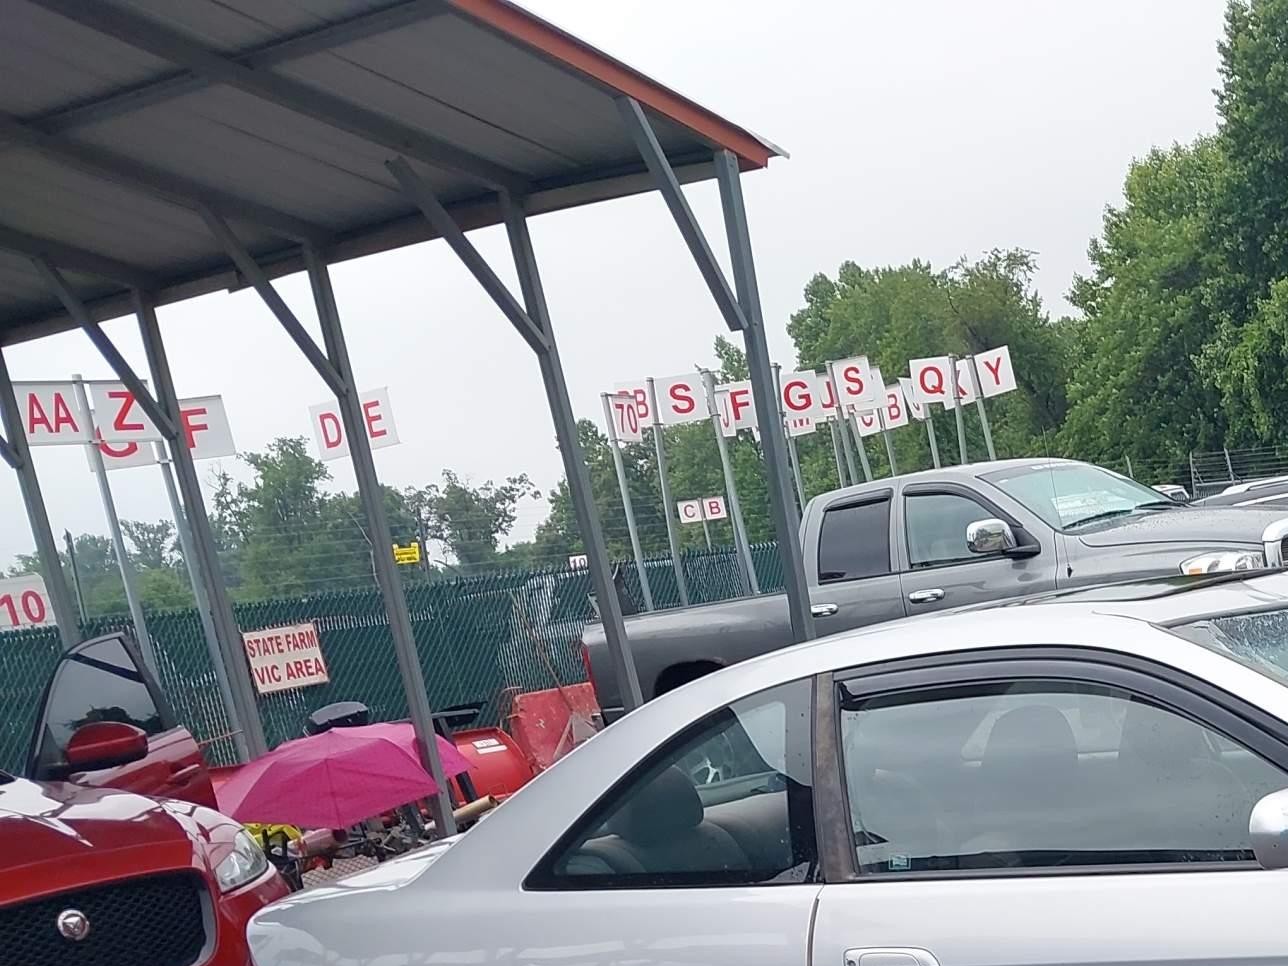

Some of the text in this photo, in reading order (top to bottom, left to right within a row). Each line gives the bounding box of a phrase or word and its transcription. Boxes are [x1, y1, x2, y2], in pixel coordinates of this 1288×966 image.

[843, 366, 864, 395] S
[919, 366, 945, 395] Q
[983, 357, 1001, 385] Y
[669, 383, 696, 414] S
[730, 389, 749, 420] F
[783, 381, 812, 411] G
[28, 392, 79, 433] AA
[107, 392, 145, 431] Z
[363, 400, 387, 438] E
[614, 403, 638, 433] 70
[179, 408, 208, 448] F
[318, 412, 342, 448] D
[683, 501, 721, 518] C B
[247, 630, 317, 658] STATE FARM
[254, 657, 326, 685] VIC AREA
